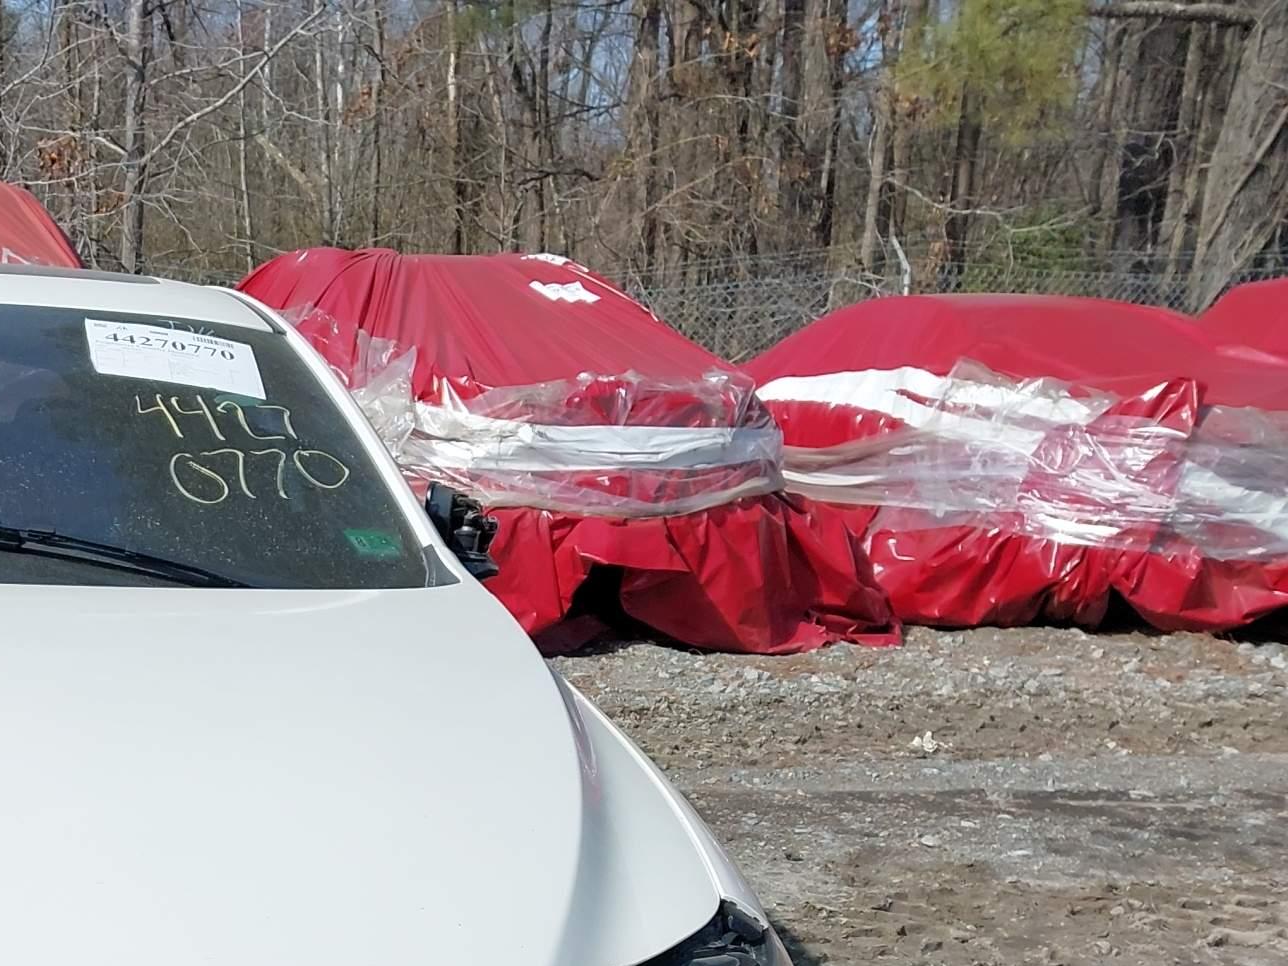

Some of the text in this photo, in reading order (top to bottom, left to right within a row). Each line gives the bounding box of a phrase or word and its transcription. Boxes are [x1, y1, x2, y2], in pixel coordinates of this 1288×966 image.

[105, 333, 235, 360] 44270770
[135, 393, 298, 441] 4427
[169, 448, 350, 504] 0770
